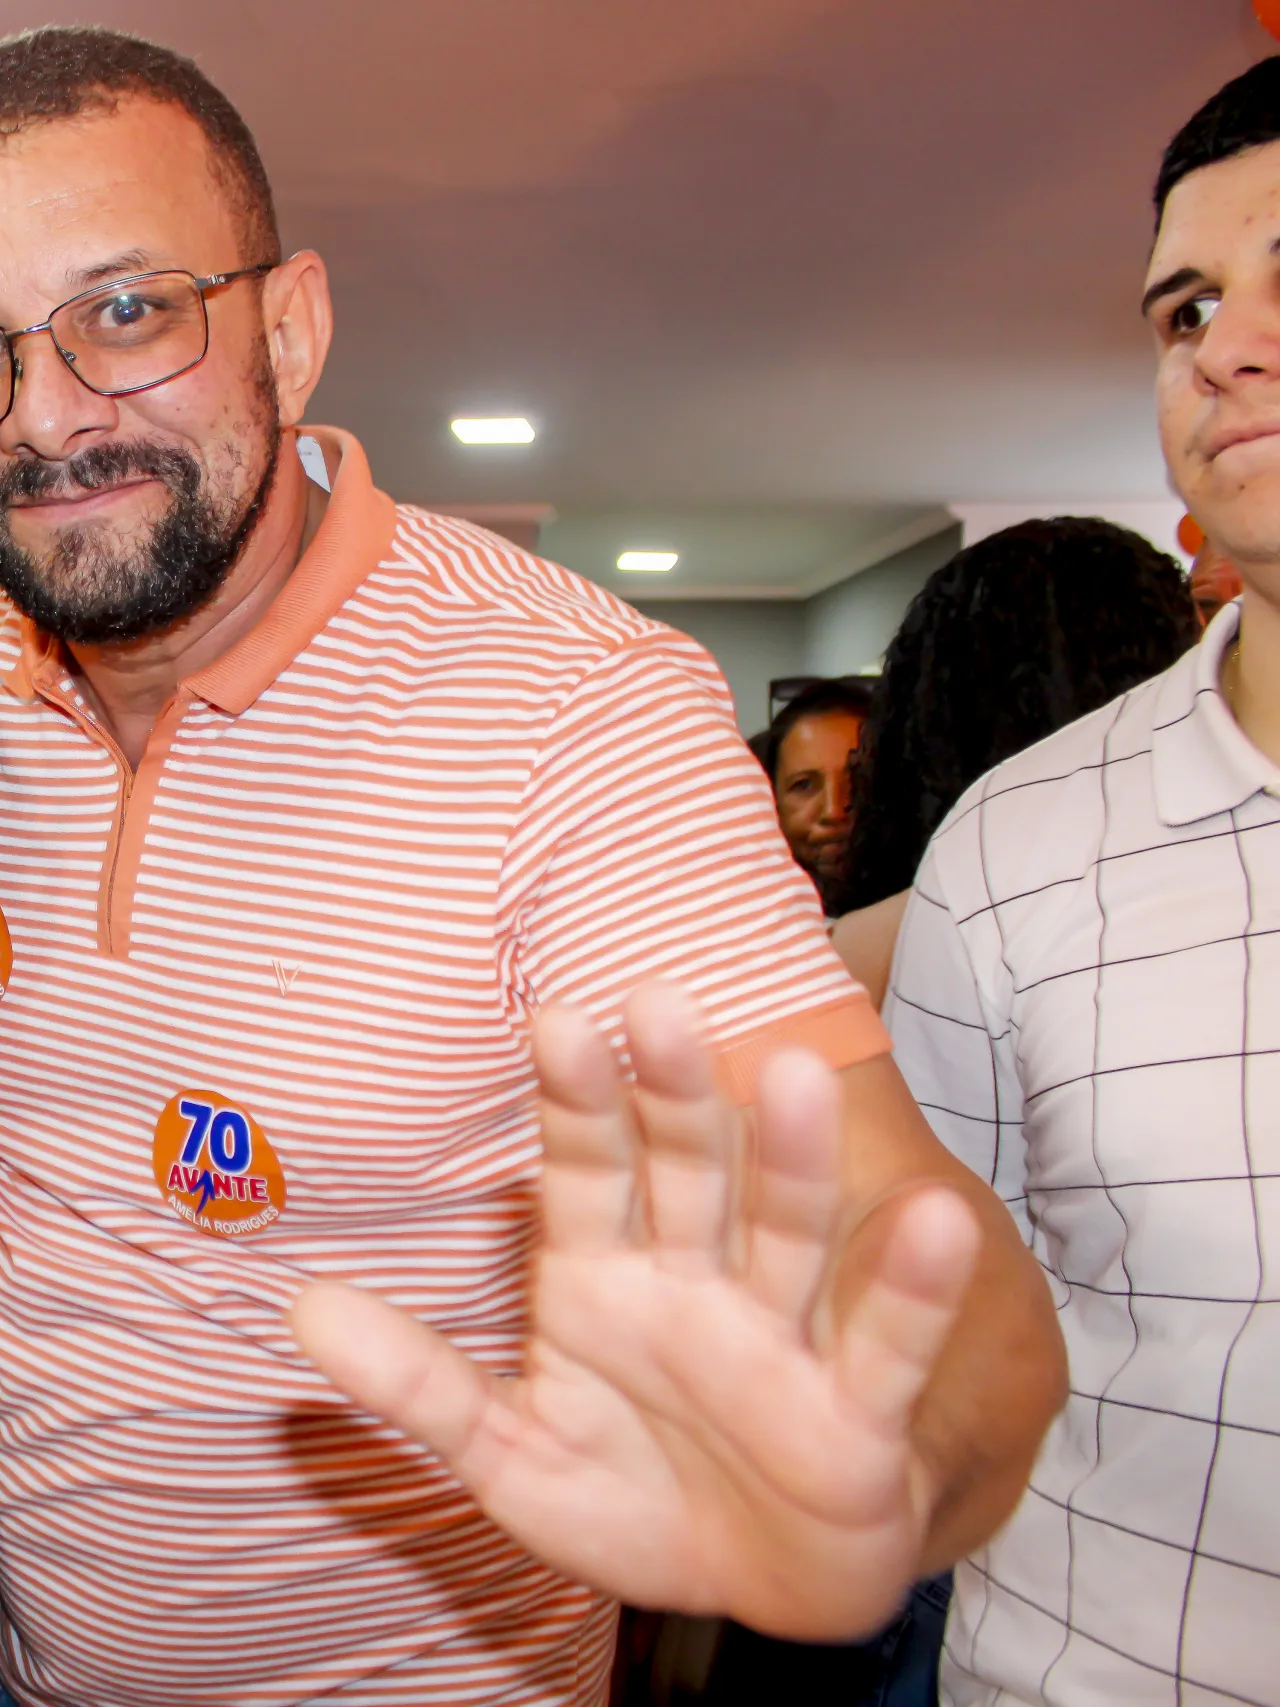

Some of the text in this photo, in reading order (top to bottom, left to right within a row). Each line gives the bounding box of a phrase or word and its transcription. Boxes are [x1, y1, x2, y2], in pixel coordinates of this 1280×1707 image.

[179, 1100, 253, 1175] 70
[167, 1164, 270, 1215] AVANTE
[168, 1195, 280, 1235] AMÉLIA RODRIGUES
